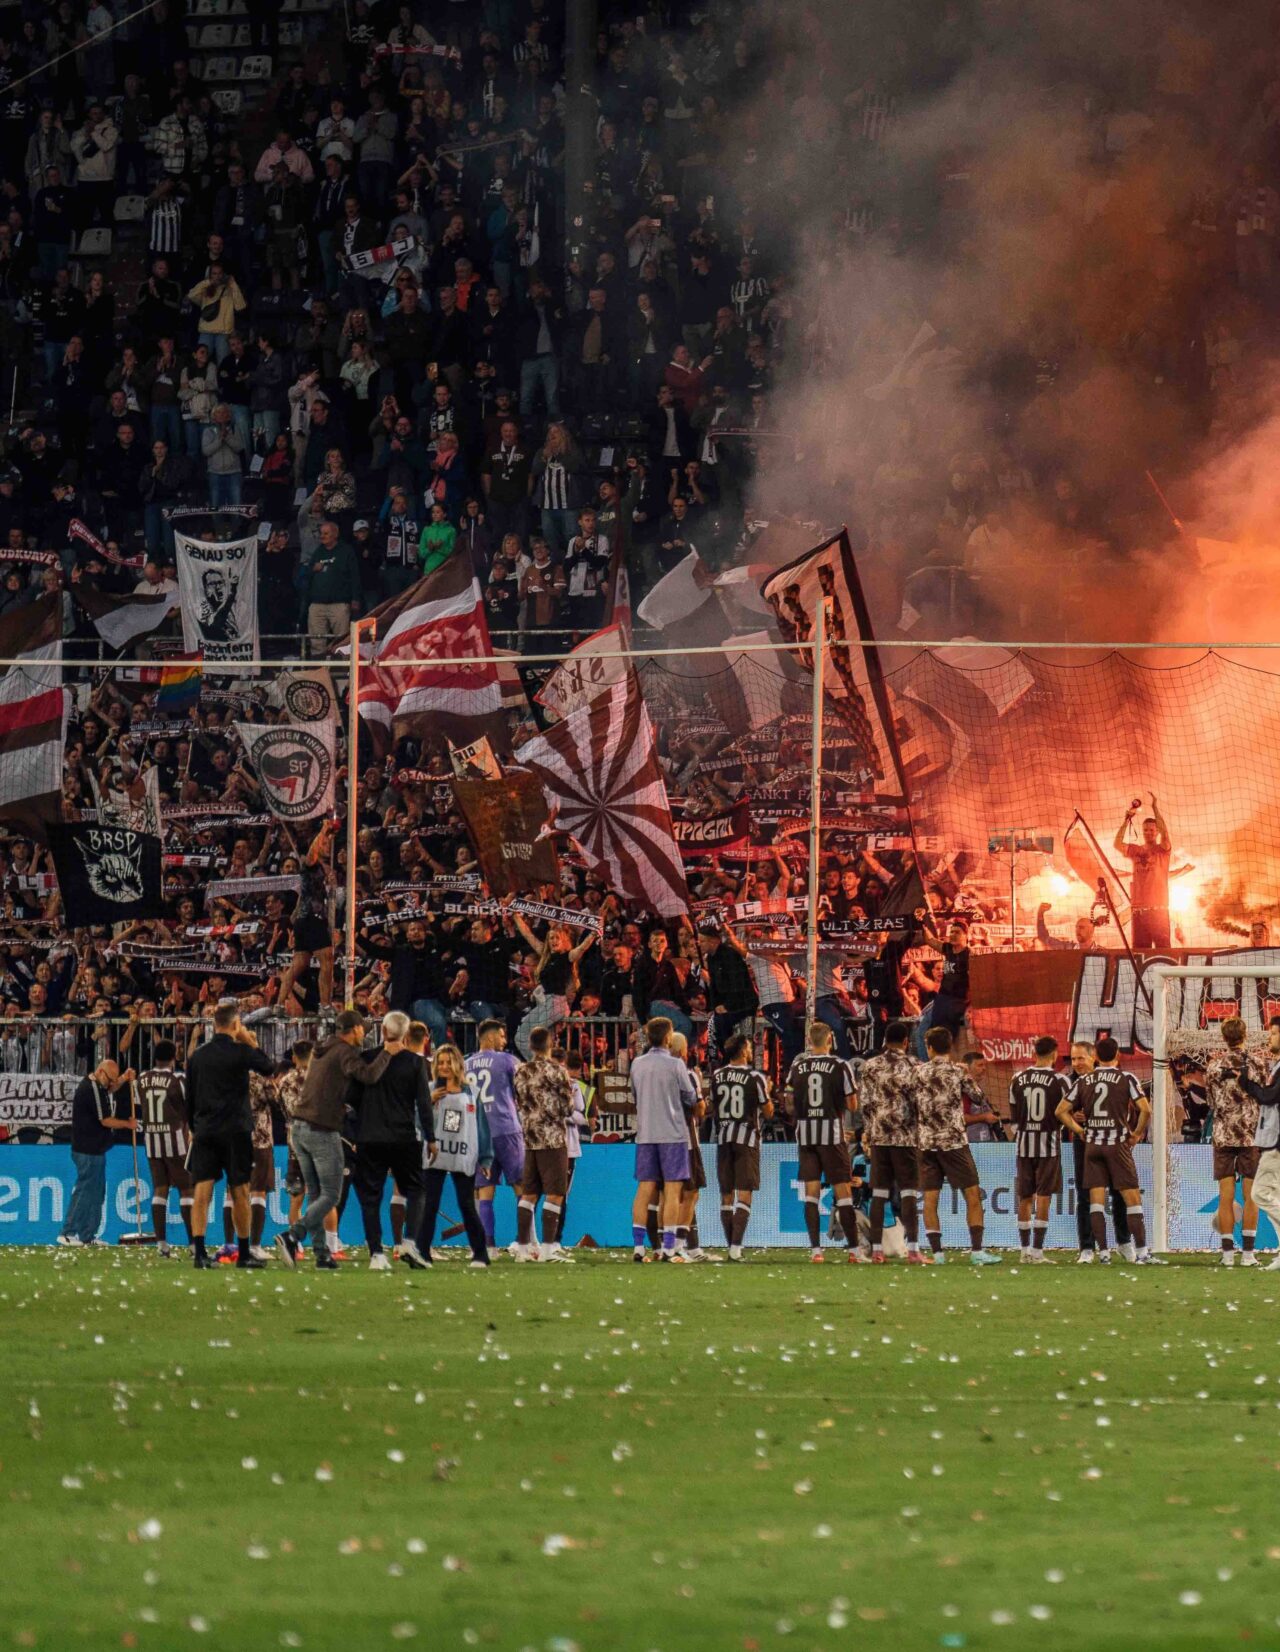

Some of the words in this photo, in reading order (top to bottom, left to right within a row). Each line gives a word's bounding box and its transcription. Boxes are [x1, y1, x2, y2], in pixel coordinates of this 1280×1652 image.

[185, 544, 223, 562] GENAU
[227, 547, 246, 560] SO!
[288, 759, 310, 774] SP
[86, 829, 137, 851] BRSP
[798, 1064, 810, 1074] ST.
[811, 1061, 835, 1074] PAULI
[152, 1075, 171, 1089] PAULI
[715, 1074, 727, 1084] ST.
[727, 1072, 749, 1086] PAULI
[1018, 1075, 1030, 1087] ST.
[1030, 1073, 1054, 1087] PAULI
[1085, 1074, 1097, 1086] ST.
[1098, 1072, 1122, 1084] PAULI
[808, 1073, 824, 1108] 8
[146, 1089, 167, 1123] 17
[717, 1084, 745, 1119] 28
[1023, 1086, 1046, 1122] 10
[1093, 1082, 1109, 1117] 2
[807, 1108, 824, 1118] SMITH
